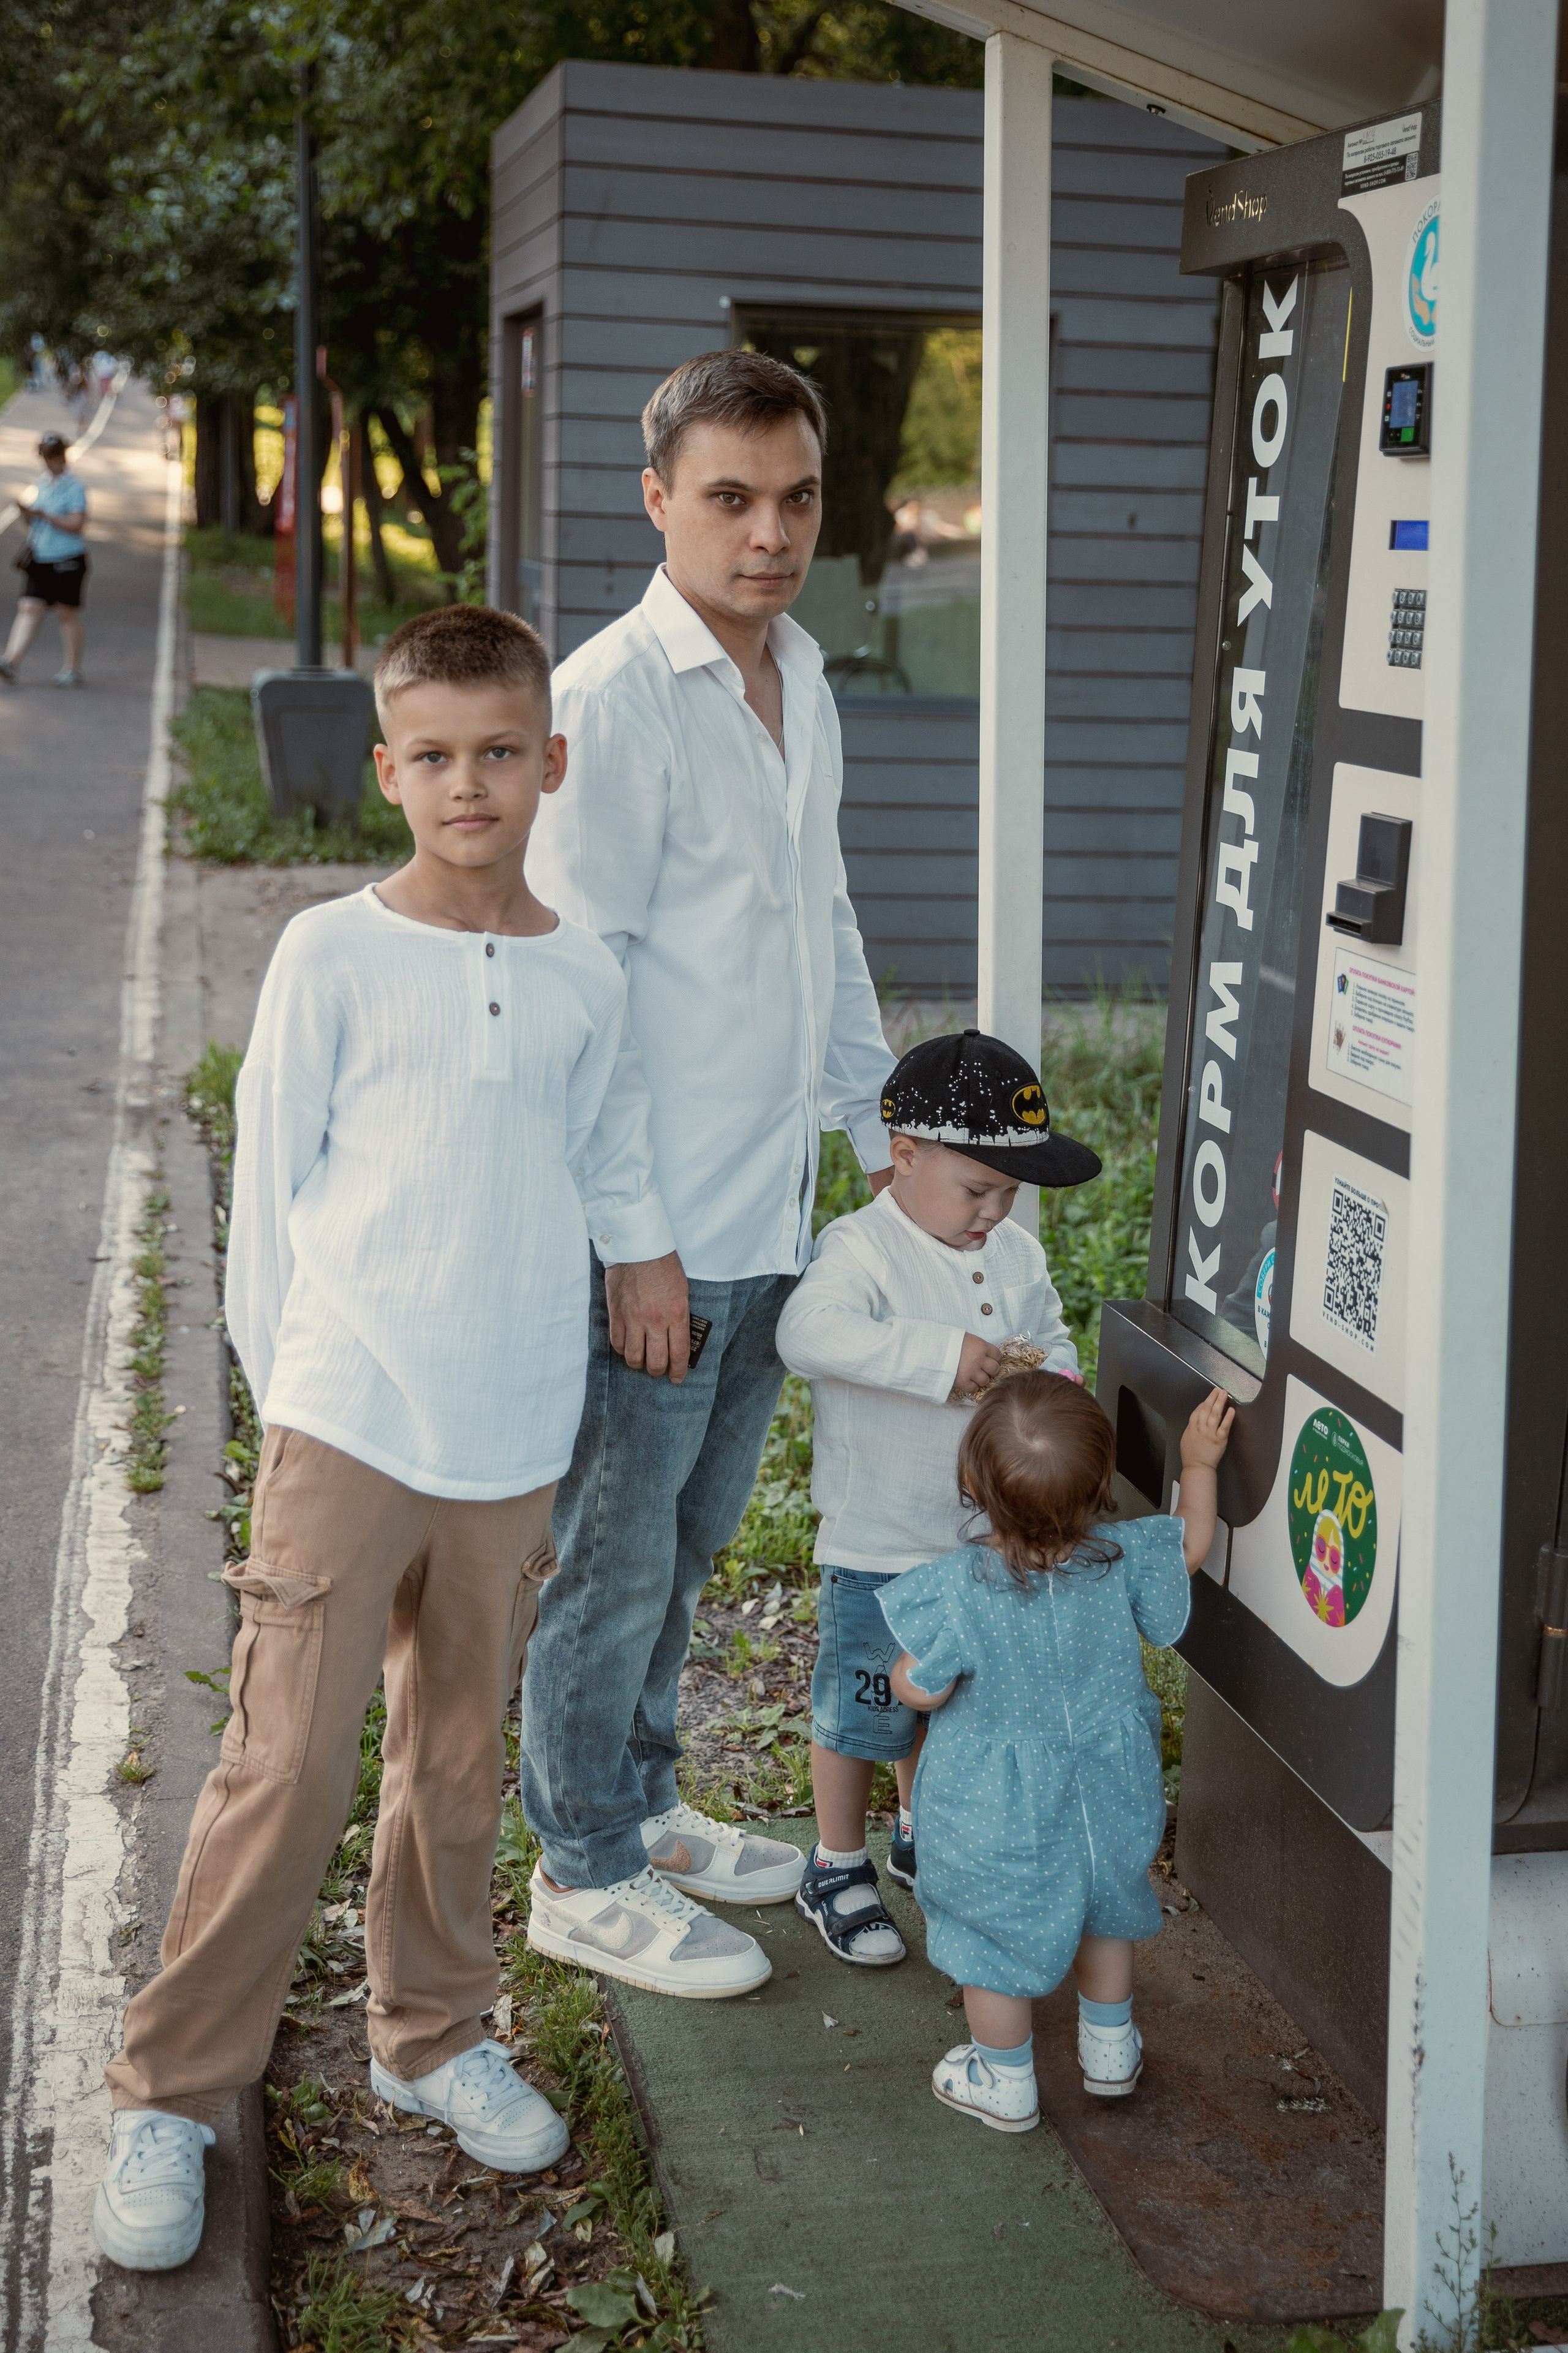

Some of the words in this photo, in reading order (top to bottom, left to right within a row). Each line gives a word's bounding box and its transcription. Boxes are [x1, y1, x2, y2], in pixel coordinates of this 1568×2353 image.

[1364, 147, 1396, 163] 8-925-055-19-48
[1238, 273, 1298, 627] УТОК
[1216, 667, 1265, 931] ДЛЯ
[1349, 967, 1361, 976] ОПЛАТА
[1362, 972, 1378, 981] ПОКУПКИ
[1378, 978, 1401, 990] БАНКОВСКОЙ
[1352, 1025, 1365, 1035] ОПЛАТА
[1365, 1030, 1381, 1041] ПОКУПКИ
[1185, 962, 1242, 1315] КОРМ
[1335, 1176, 1351, 1192] УЗНАЙТЕ
[1351, 1187, 1366, 1201] БОЛЬШЕ
[1370, 1198, 1381, 1208] ПРО
[1258, 1260, 1271, 1293] СОБЕРИ
[1322, 1310, 1374, 1352] VEND-SHOP.COM
[1337, 1442, 1363, 1467] ПОДМОСКОВЬЯ
[1338, 1435, 1350, 1449] ПАРКИ
[855, 1669, 903, 1707] 29
[818, 1874, 850, 1888] OVERLIMIT
